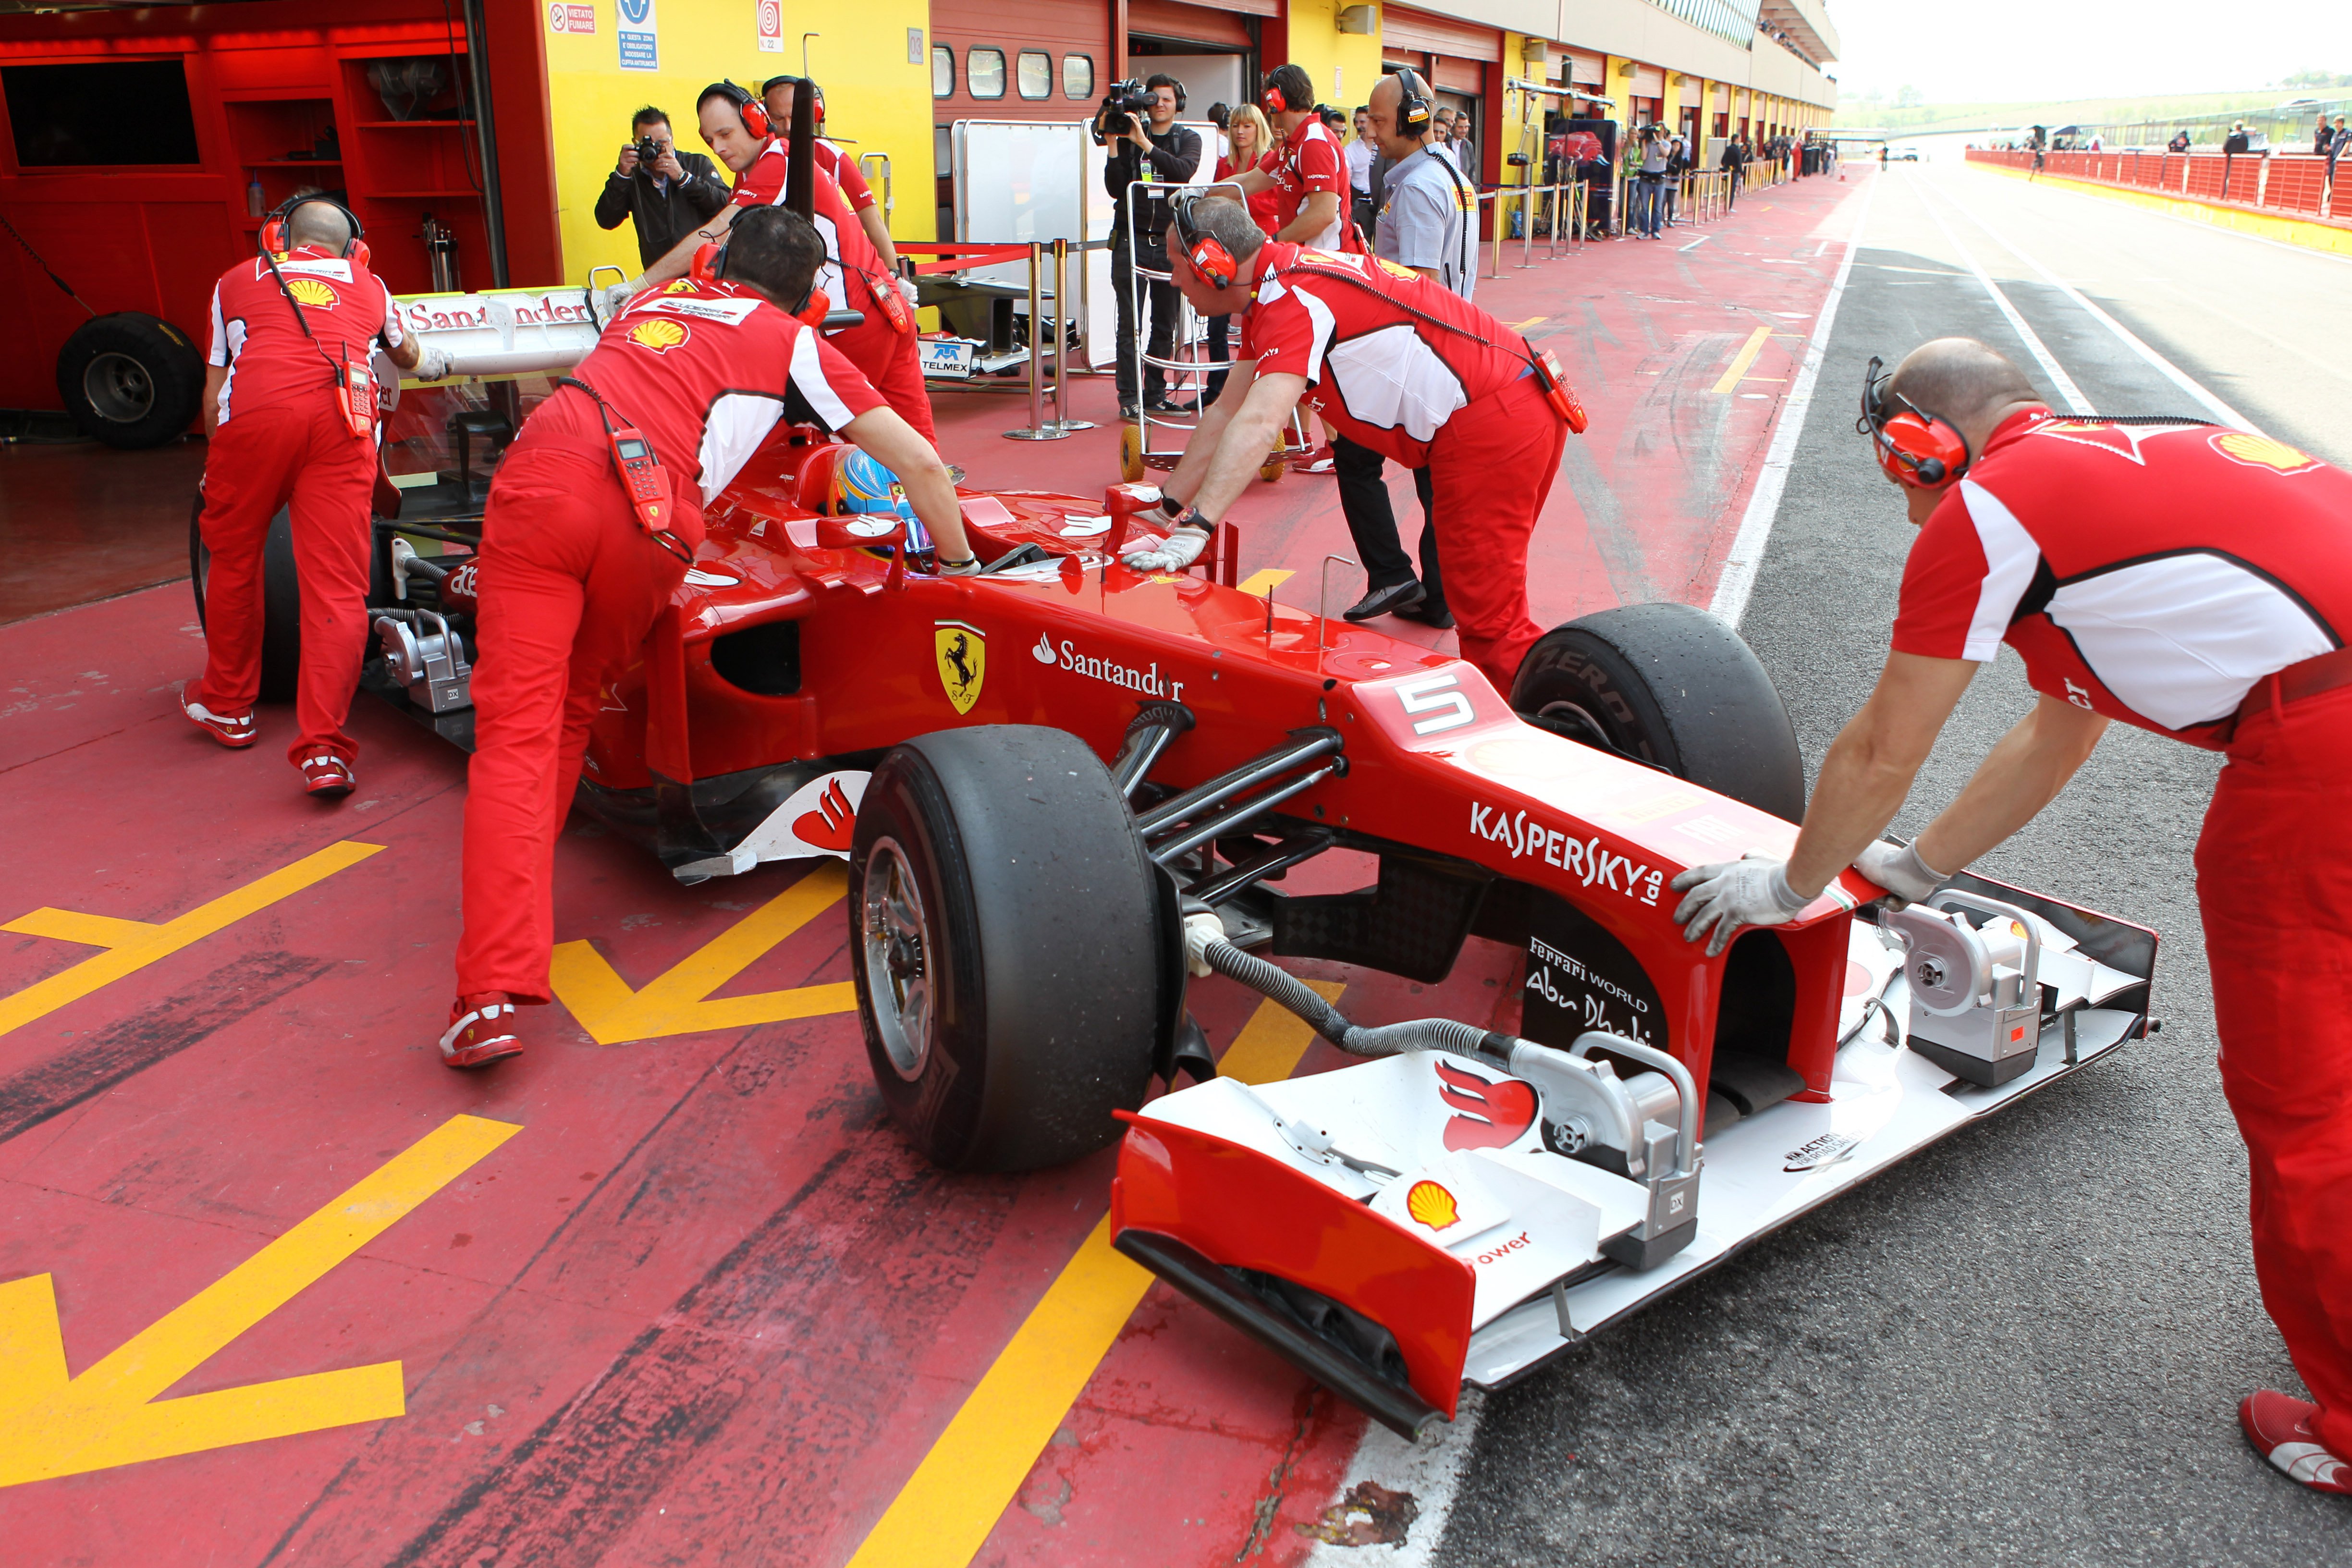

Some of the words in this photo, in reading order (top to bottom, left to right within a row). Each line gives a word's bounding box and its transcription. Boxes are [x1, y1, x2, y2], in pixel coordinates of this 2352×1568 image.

[568, 9, 592, 19] VIETATO
[569, 20, 594, 30] FUMARE
[626, 42, 653, 50] OBBLIGATORIO
[767, 40, 774, 48] 22
[910, 37, 922, 55] 03
[409, 296, 589, 331] Santnder
[663, 301, 723, 313] SCUDERIA
[922, 361, 968, 372] TELMEX
[451, 565, 478, 598] ace
[1537, 648, 1633, 723] ZERO
[1393, 674, 1476, 737] 5
[1470, 801, 1648, 897] KASPERSKY
[1640, 870, 1664, 907] lab
[1530, 936, 1585, 981] Ferrari
[1590, 972, 1648, 1013] WORLD
[1526, 966, 1577, 1011] Abu
[1800, 1132, 1841, 1154] ACTION
[1797, 1157, 1812, 1166] FOR
[1810, 1146, 1837, 1160] ROAD
